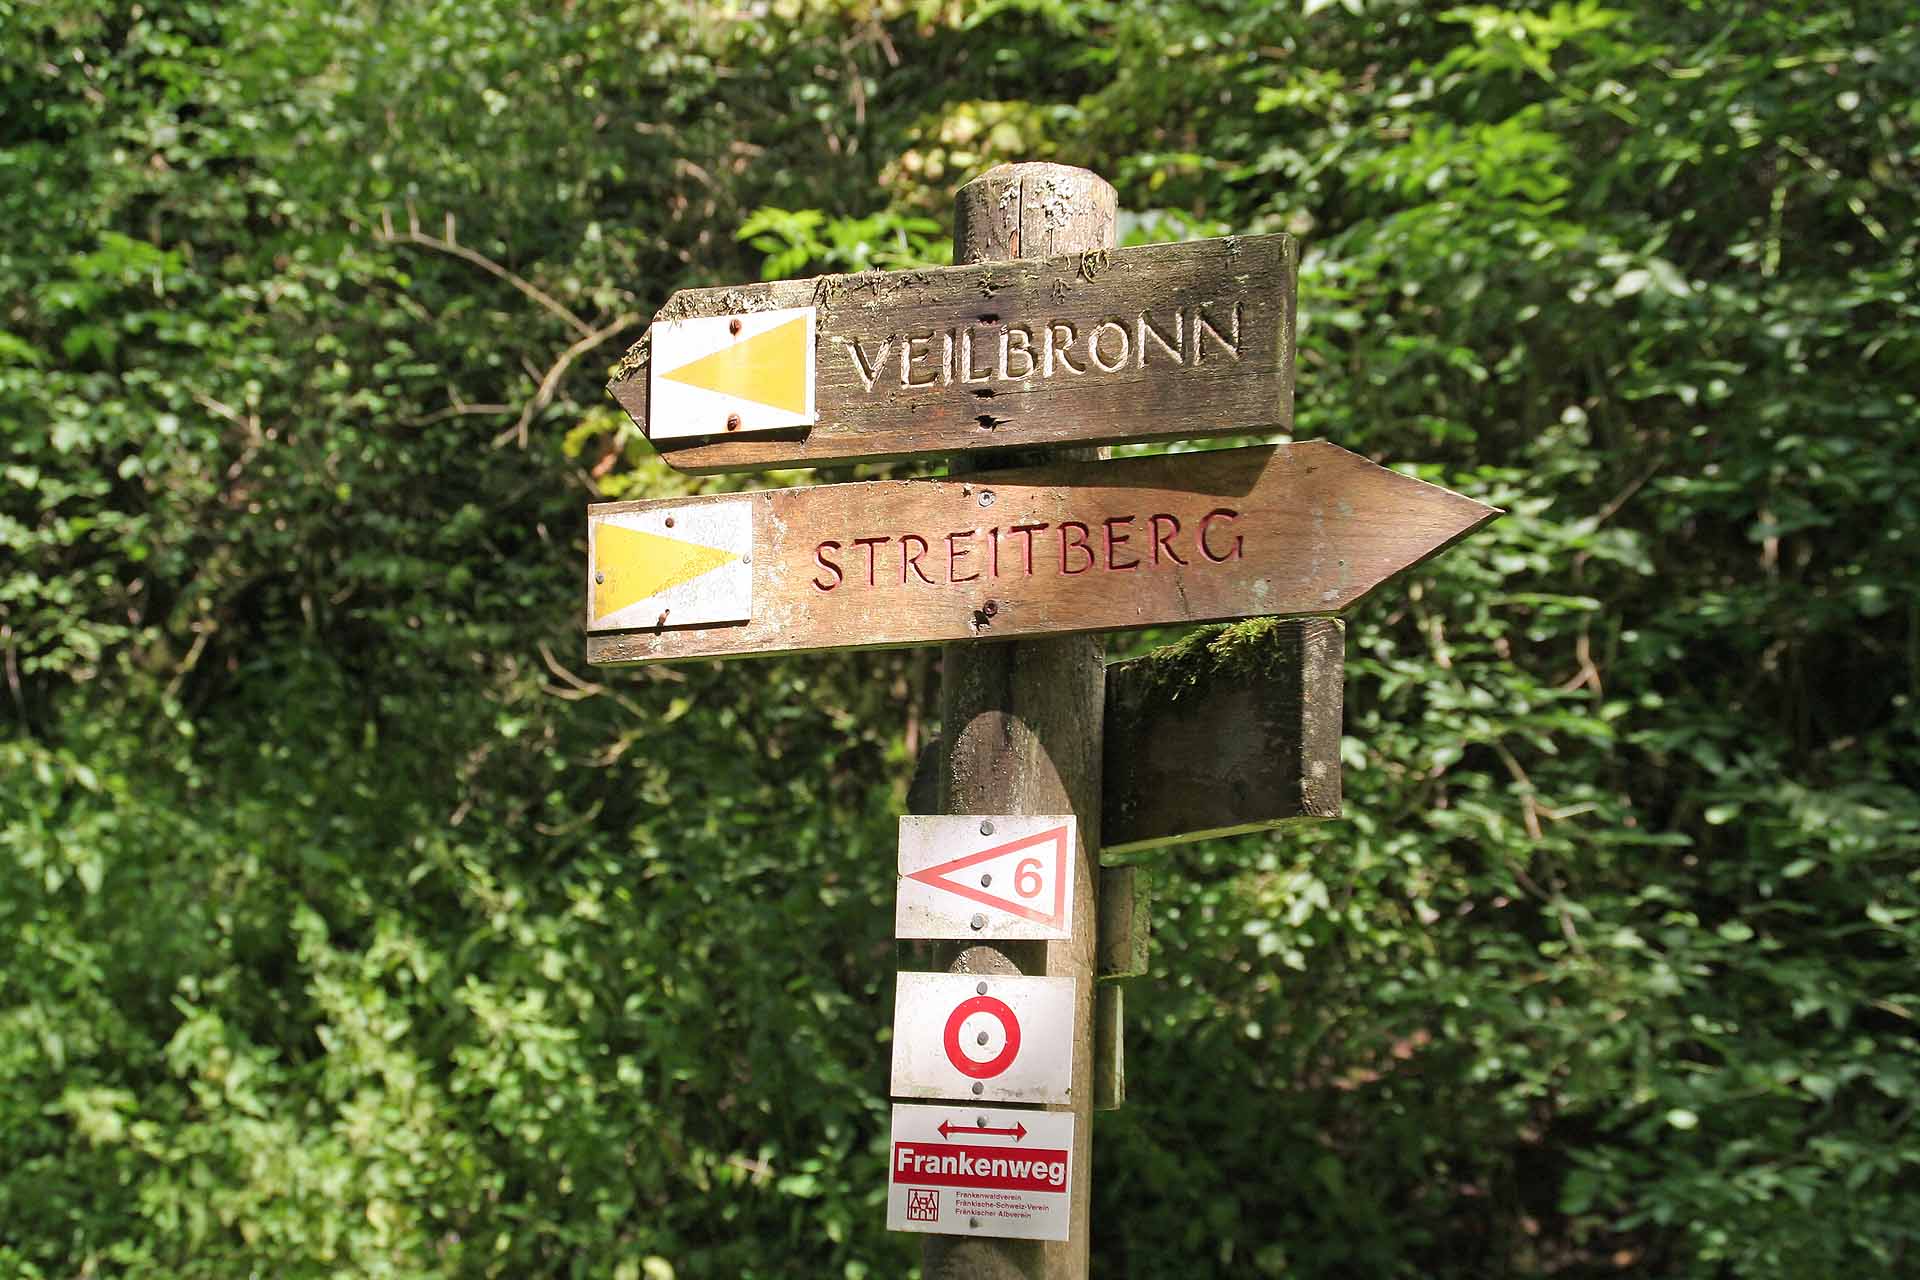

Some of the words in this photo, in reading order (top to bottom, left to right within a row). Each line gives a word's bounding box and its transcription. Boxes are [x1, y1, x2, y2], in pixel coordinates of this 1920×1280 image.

[845, 302, 1243, 393] VEILBRONN
[812, 507, 1244, 592] STREITBERG
[1014, 858, 1043, 898] 6
[897, 1148, 1066, 1185] Frankenweg
[955, 1191, 1022, 1201] Frankenwaldverein
[998, 1210, 1032, 1219] Albverein
